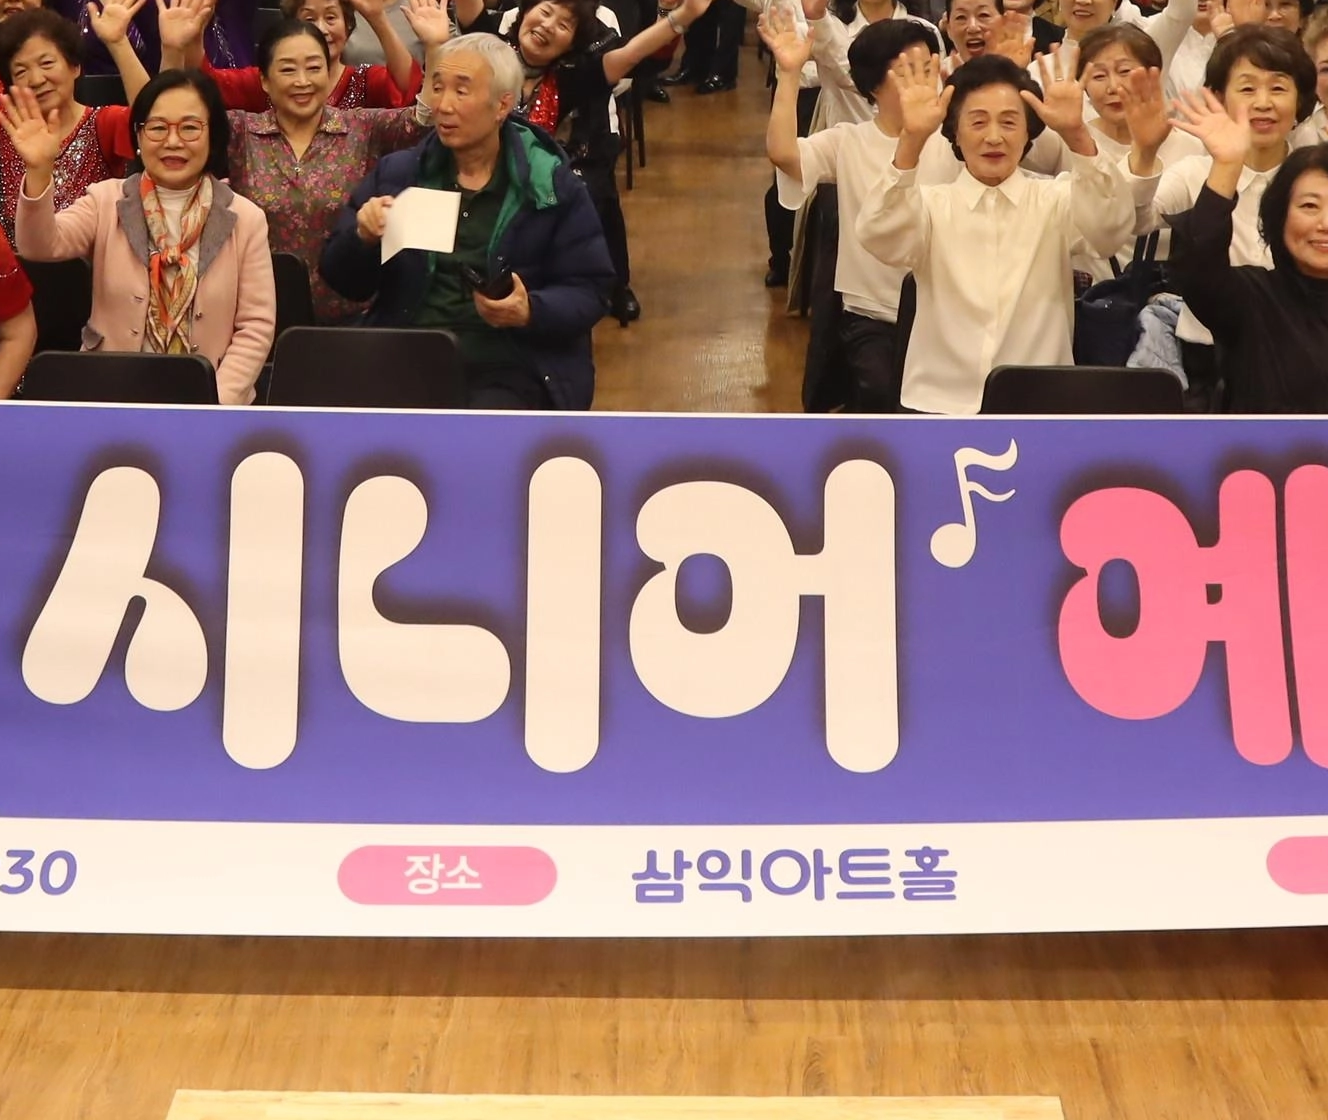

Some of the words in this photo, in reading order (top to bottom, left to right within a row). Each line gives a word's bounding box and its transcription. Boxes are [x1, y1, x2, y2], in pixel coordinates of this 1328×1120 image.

[21, 450, 901, 774] 시니어
[403, 852, 484, 895] 장소
[630, 845, 958, 905] 삼익아트홀
